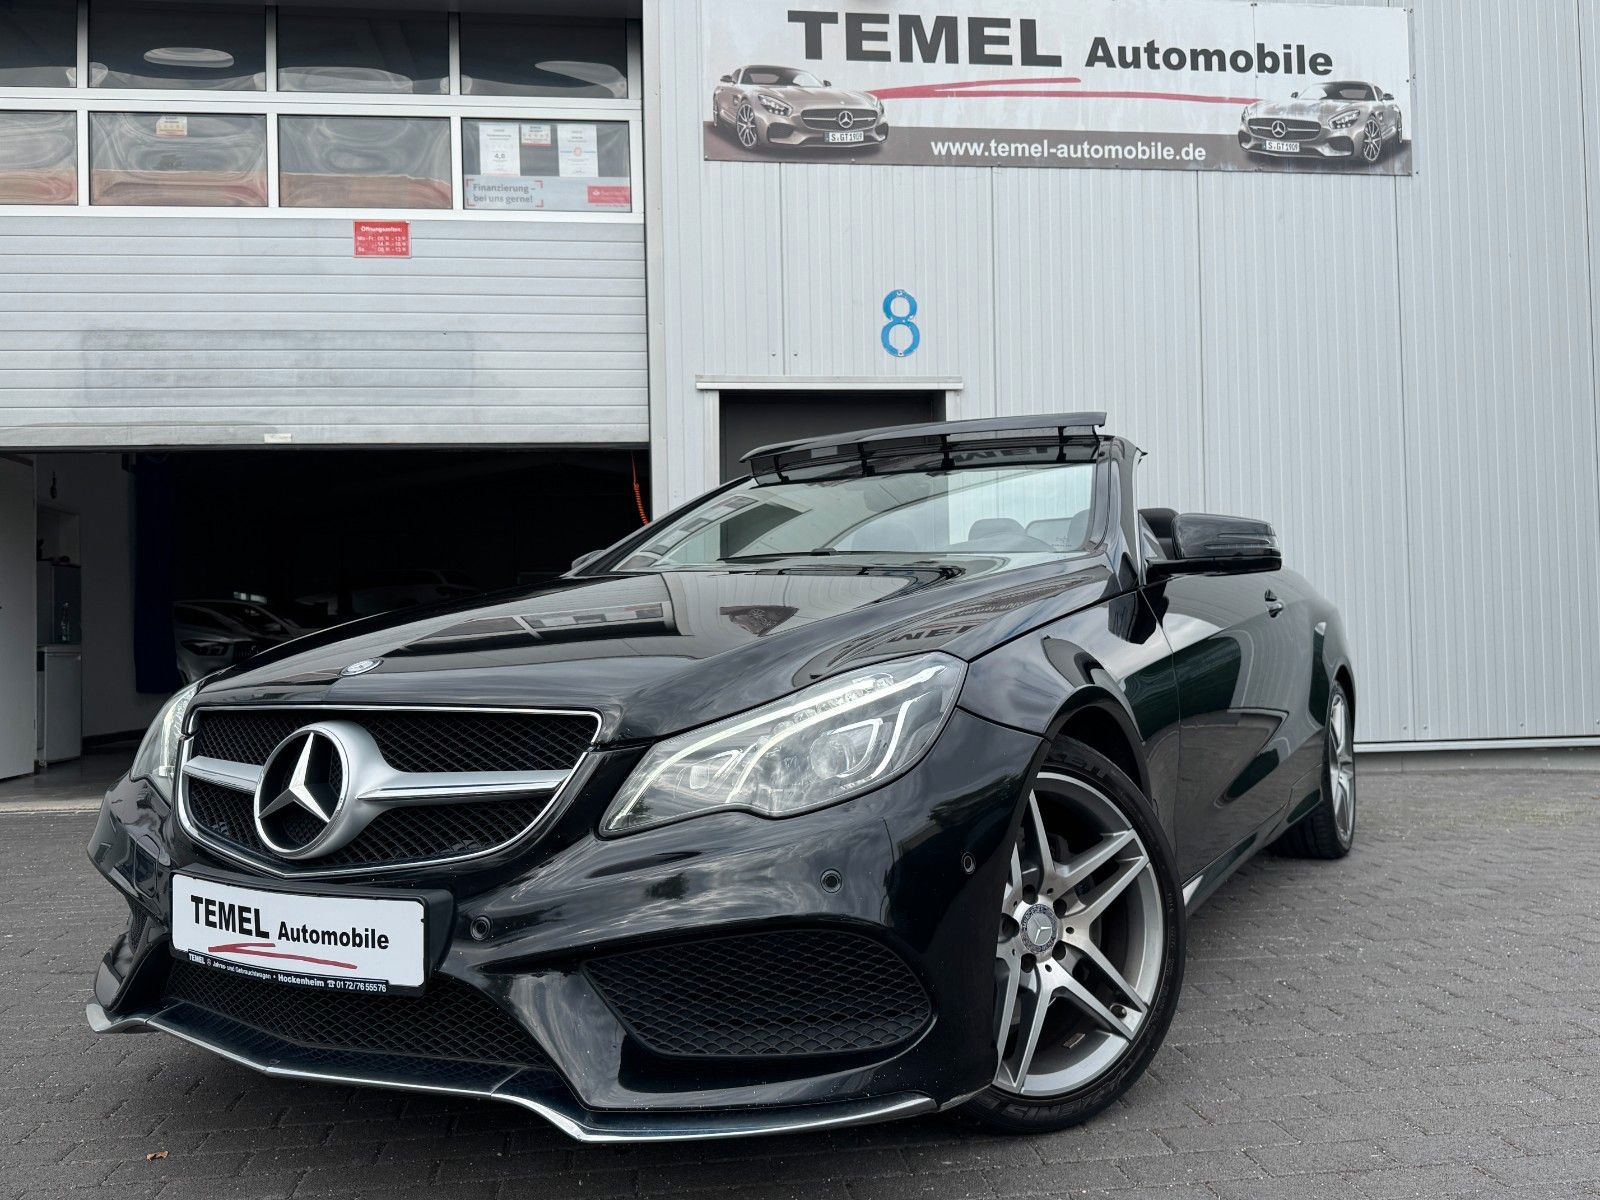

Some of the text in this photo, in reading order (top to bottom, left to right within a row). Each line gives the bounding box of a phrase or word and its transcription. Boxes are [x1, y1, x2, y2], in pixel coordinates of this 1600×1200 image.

[787, 10, 1333, 76] TEMEL Automobile
[930, 138, 1207, 162] www.temel-automobile.de
[473, 183, 529, 194] Finanzierung
[473, 193, 534, 205] bei uns gerne!
[881, 288, 920, 358] 8
[190, 894, 390, 950] TEMEL Automobile
[188, 953, 206, 965] TEMEL
[277, 973, 325, 987] Hockenheim
